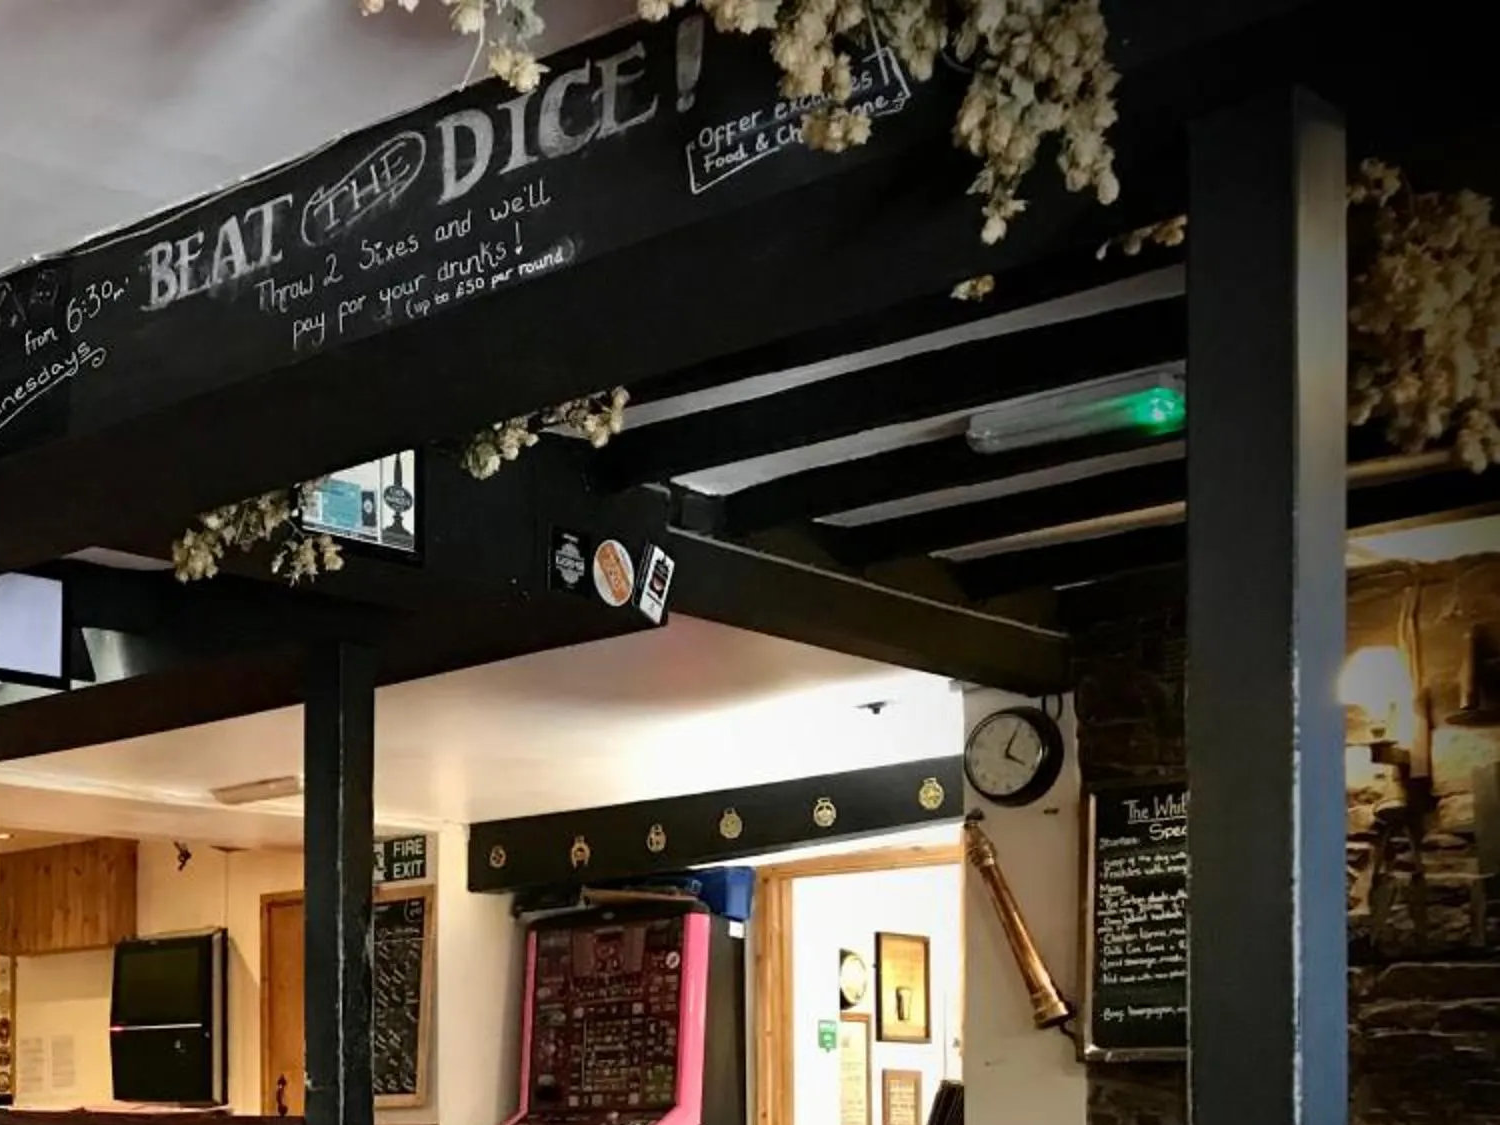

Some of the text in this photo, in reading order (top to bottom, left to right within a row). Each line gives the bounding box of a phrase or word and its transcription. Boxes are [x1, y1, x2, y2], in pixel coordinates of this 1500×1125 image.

[699, 109, 764, 156] Offer
[141, 194, 293, 312] BEAT
[314, 141, 410, 232] THE
[436, 41, 660, 206] DICE
[676, 15, 704, 113] !
[704, 142, 748, 173] Food
[254, 179, 552, 312] Throw 2 Sixes and we'll
[293, 311, 325, 350] pay
[338, 294, 367, 333] for
[379, 274, 426, 326] your
[436, 241, 507, 282] drinks
[455, 276, 486, 300] £50
[490, 268, 513, 290] per
[24, 326, 60, 355] from
[1123, 790, 1189, 819] The Whit
[393, 838, 424, 858] FIRE
[393, 860, 424, 878] EXIT
